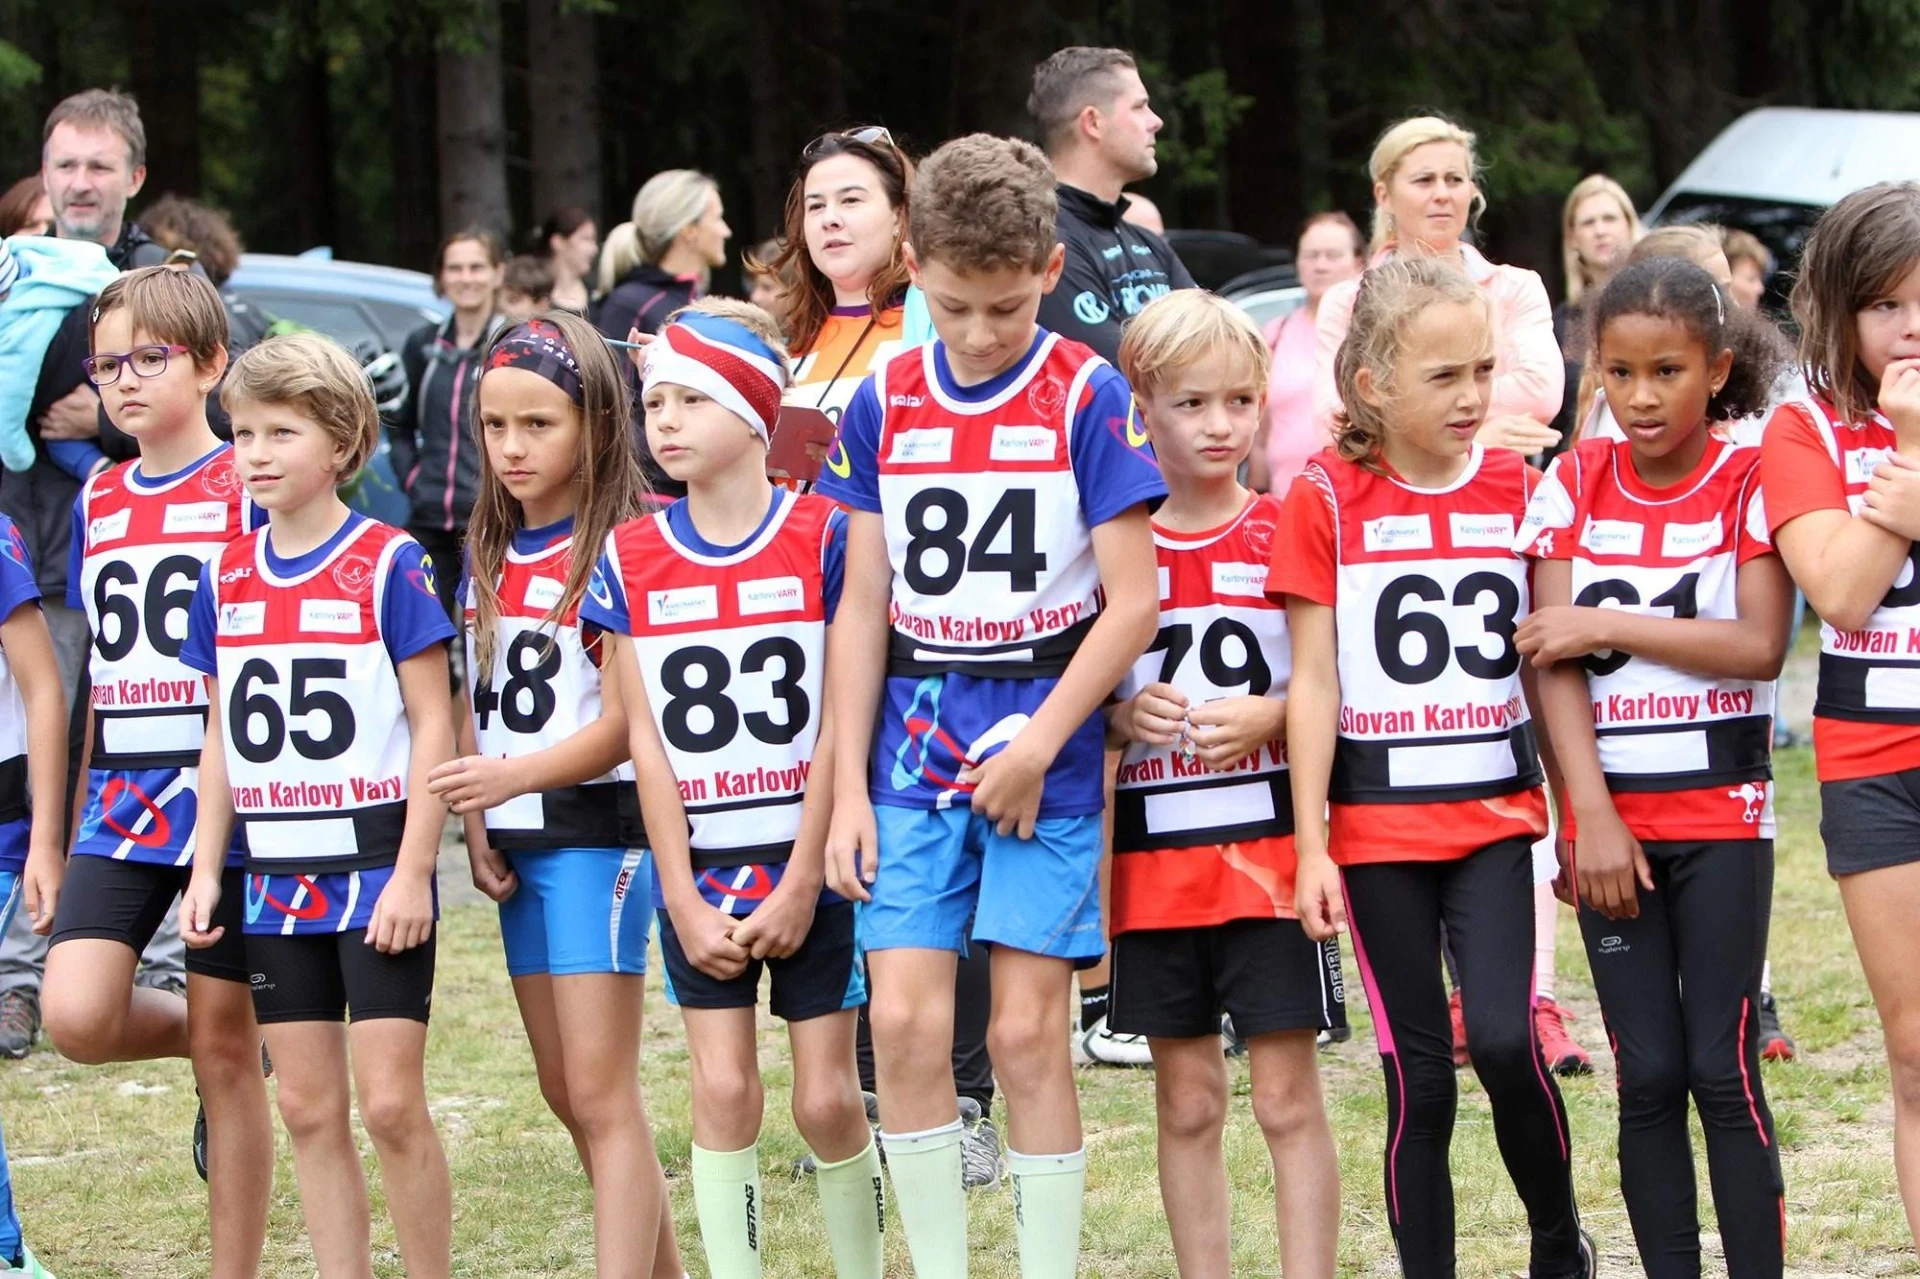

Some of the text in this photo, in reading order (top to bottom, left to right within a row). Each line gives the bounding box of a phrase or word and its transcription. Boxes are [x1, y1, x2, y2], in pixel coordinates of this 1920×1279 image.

[904, 487, 1047, 596] 84
[94, 554, 204, 662] 66
[938, 616, 1024, 642] Karlovy
[1030, 602, 1082, 634] Vary
[1374, 571, 1522, 684] 63
[1144, 617, 1272, 702] 79
[1834, 628, 1898, 654] Slovan
[118, 677, 196, 705] Karlovy
[229, 657, 356, 764] 65
[660, 636, 811, 753] 83
[1608, 691, 1700, 722] Karlovy
[1706, 688, 1754, 715] Vary
[1340, 705, 1415, 735] Slovan
[269, 781, 344, 808] Karlovy
[350, 775, 402, 802] Vary
[714, 766, 802, 799] Karlovy
